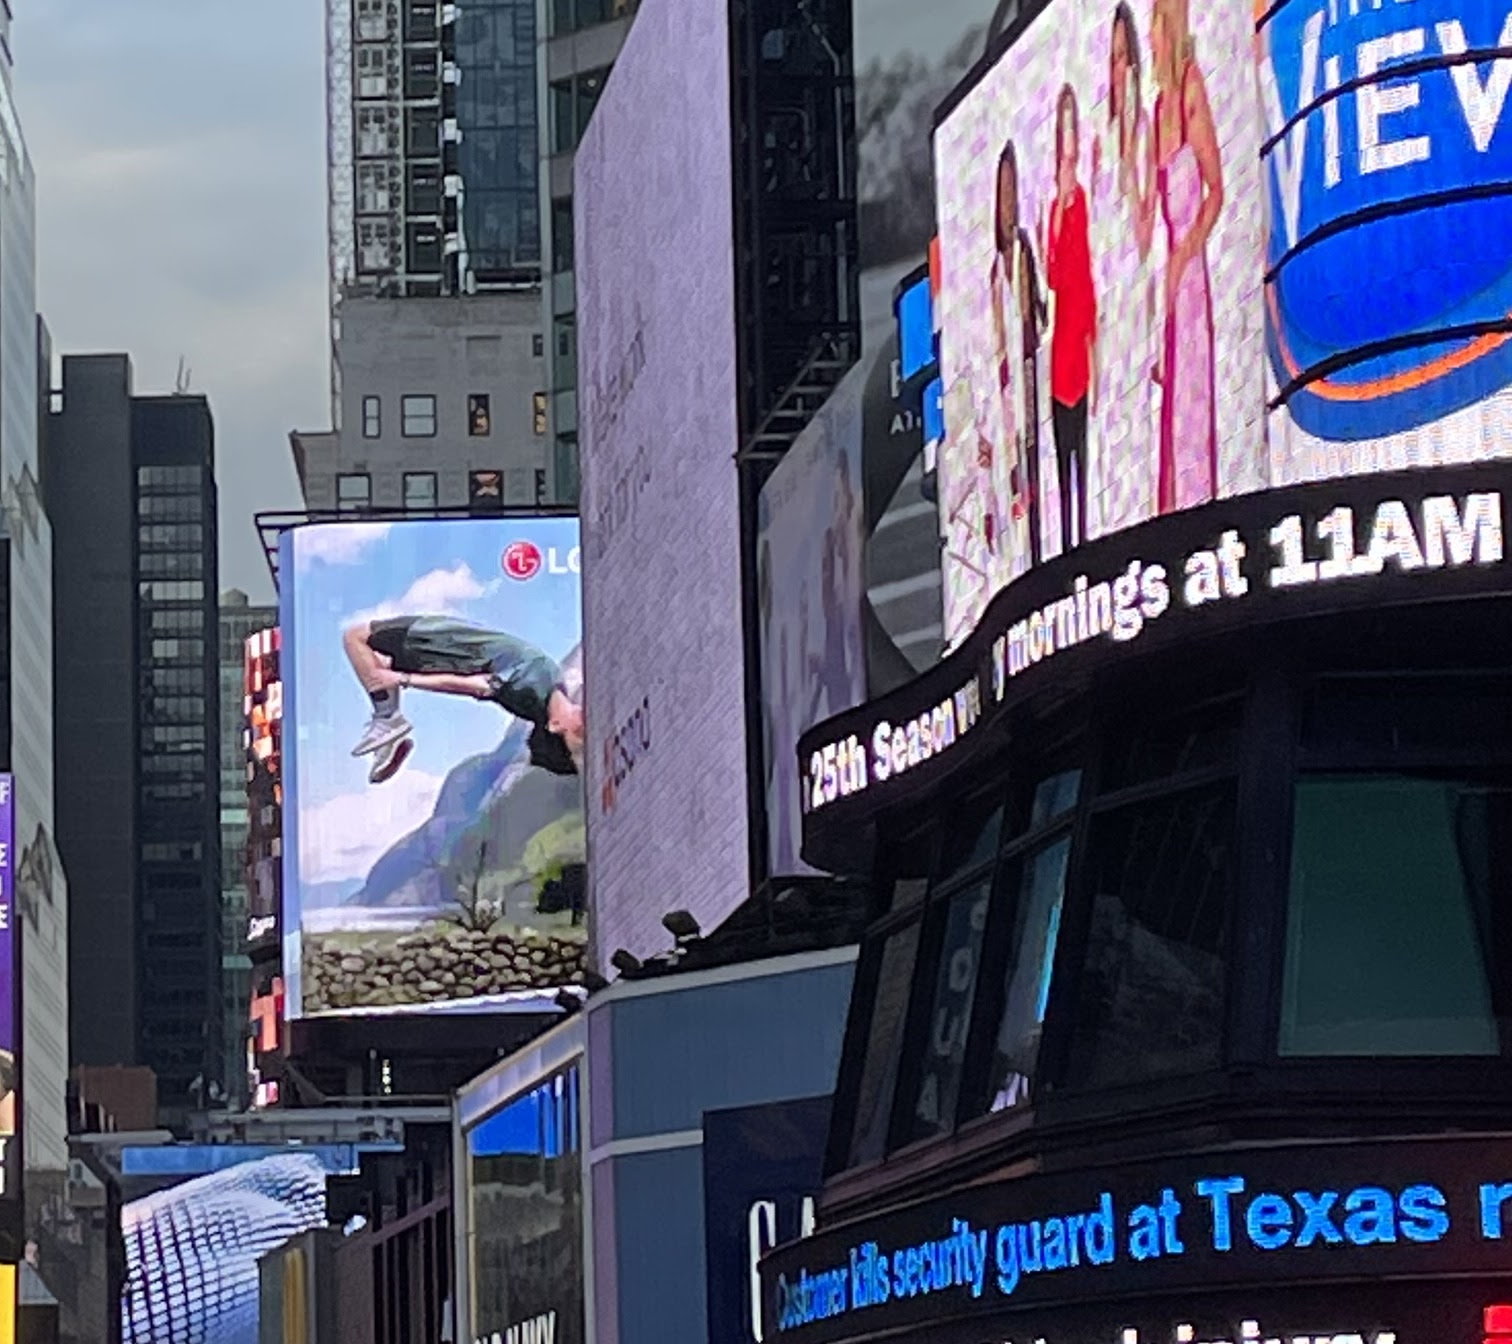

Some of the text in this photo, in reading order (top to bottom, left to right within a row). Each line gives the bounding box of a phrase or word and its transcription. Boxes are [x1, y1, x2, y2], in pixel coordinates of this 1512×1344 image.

[1006, 559, 1169, 679] mornings
[1184, 528, 1249, 606] at
[1269, 491, 1505, 588] 11AM
[811, 734, 867, 808] 25th
[872, 697, 955, 781] Season
[849, 1241, 890, 1310] kills
[892, 1217, 988, 1298] security
[996, 1192, 1114, 1294] guard
[1128, 1188, 1185, 1259] at
[1195, 1176, 1449, 1252] Texas
